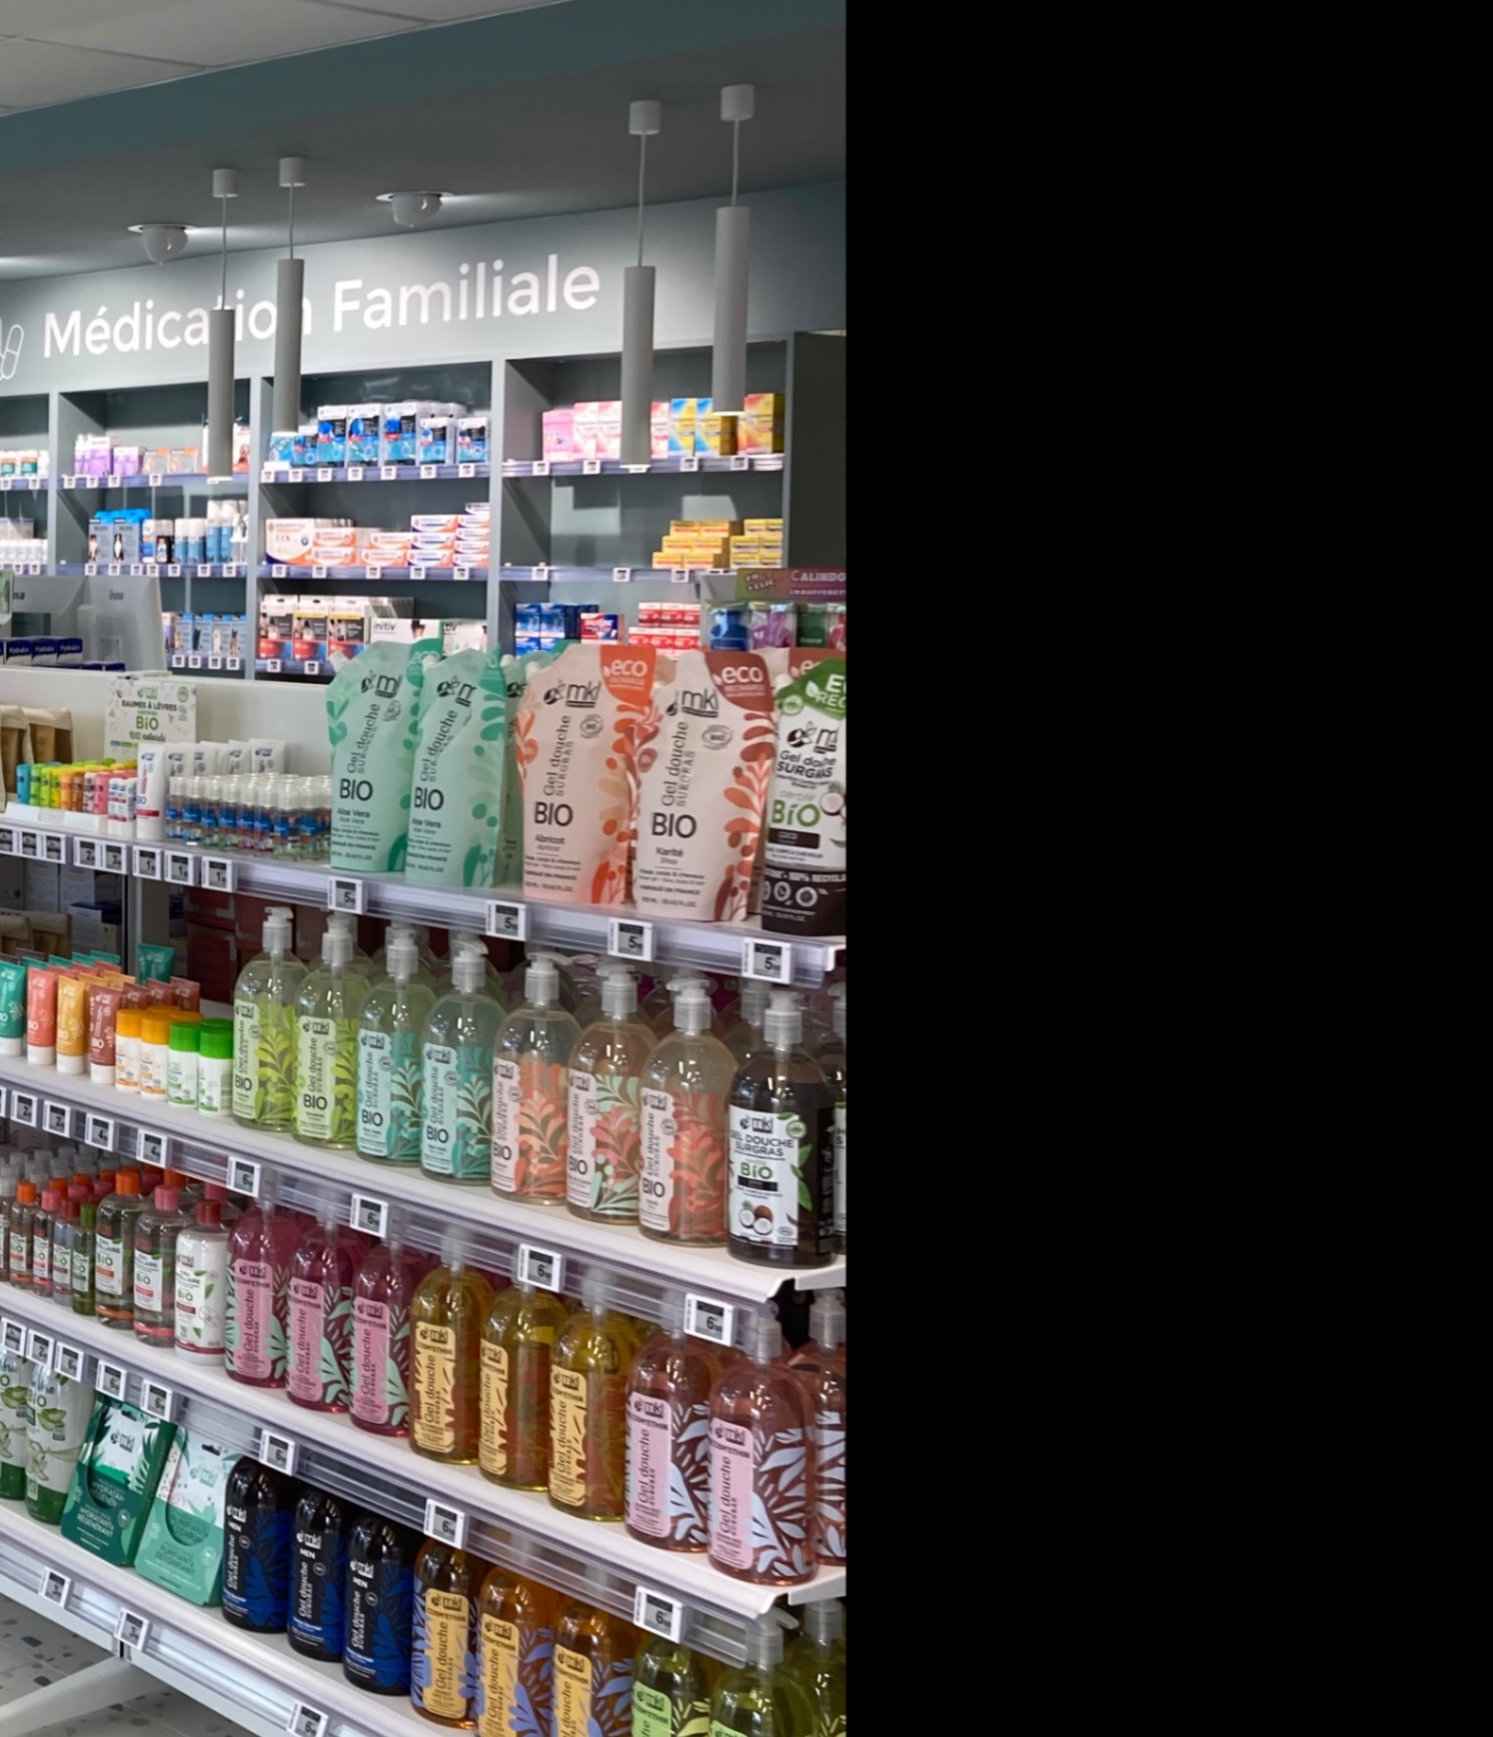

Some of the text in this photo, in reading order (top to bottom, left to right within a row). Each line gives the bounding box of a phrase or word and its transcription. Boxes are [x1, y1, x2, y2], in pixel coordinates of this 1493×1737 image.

[333, 253, 601, 332] Familiale
[611, 660, 647, 677] eco
[721, 666, 763, 683] eco
[122, 700, 146, 709] BAUMES
[154, 702, 177, 711] LÈVRES
[347, 703, 380, 774] Gel douche
[427, 709, 456, 757] douche
[543, 715, 572, 796] Gel douche
[661, 721, 689, 807] Gel douche
[339, 778, 373, 802] BIO
[414, 787, 444, 811] BIO
[352, 809, 371, 819] Vera
[424, 819, 441, 829] Vera
[534, 802, 573, 827] BIO
[652, 812, 697, 838] BIO
[535, 833, 565, 845] Abricot
[656, 847, 684, 857] Karité
[308, 1037, 317, 1072] douche
[234, 1074, 252, 1091] BIO
[303, 1094, 327, 1111] BIO
[361, 1109, 383, 1127] BIO
[427, 1125, 449, 1143] BIO
[745, 1133, 795, 1149] DOUCHE
[735, 1140, 784, 1157] SURGRAS
[642, 1177, 665, 1197] BIO
[245, 1289, 254, 1330] douche
[297, 1308, 306, 1350] douche
[362, 1328, 372, 1372] douche
[425, 1354, 435, 1399] douche
[557, 1400, 566, 1446] douche
[640, 1429, 650, 1476] douche
[721, 1456, 731, 1506] douche
[228, 1521, 241, 1532] MEN
[300, 1548, 315, 1559] MEN
[353, 1577, 368, 1588] MEN
[436, 1622, 448, 1666] douche
[488, 1649, 499, 1695] douche
[561, 1681, 571, 1728] douche
